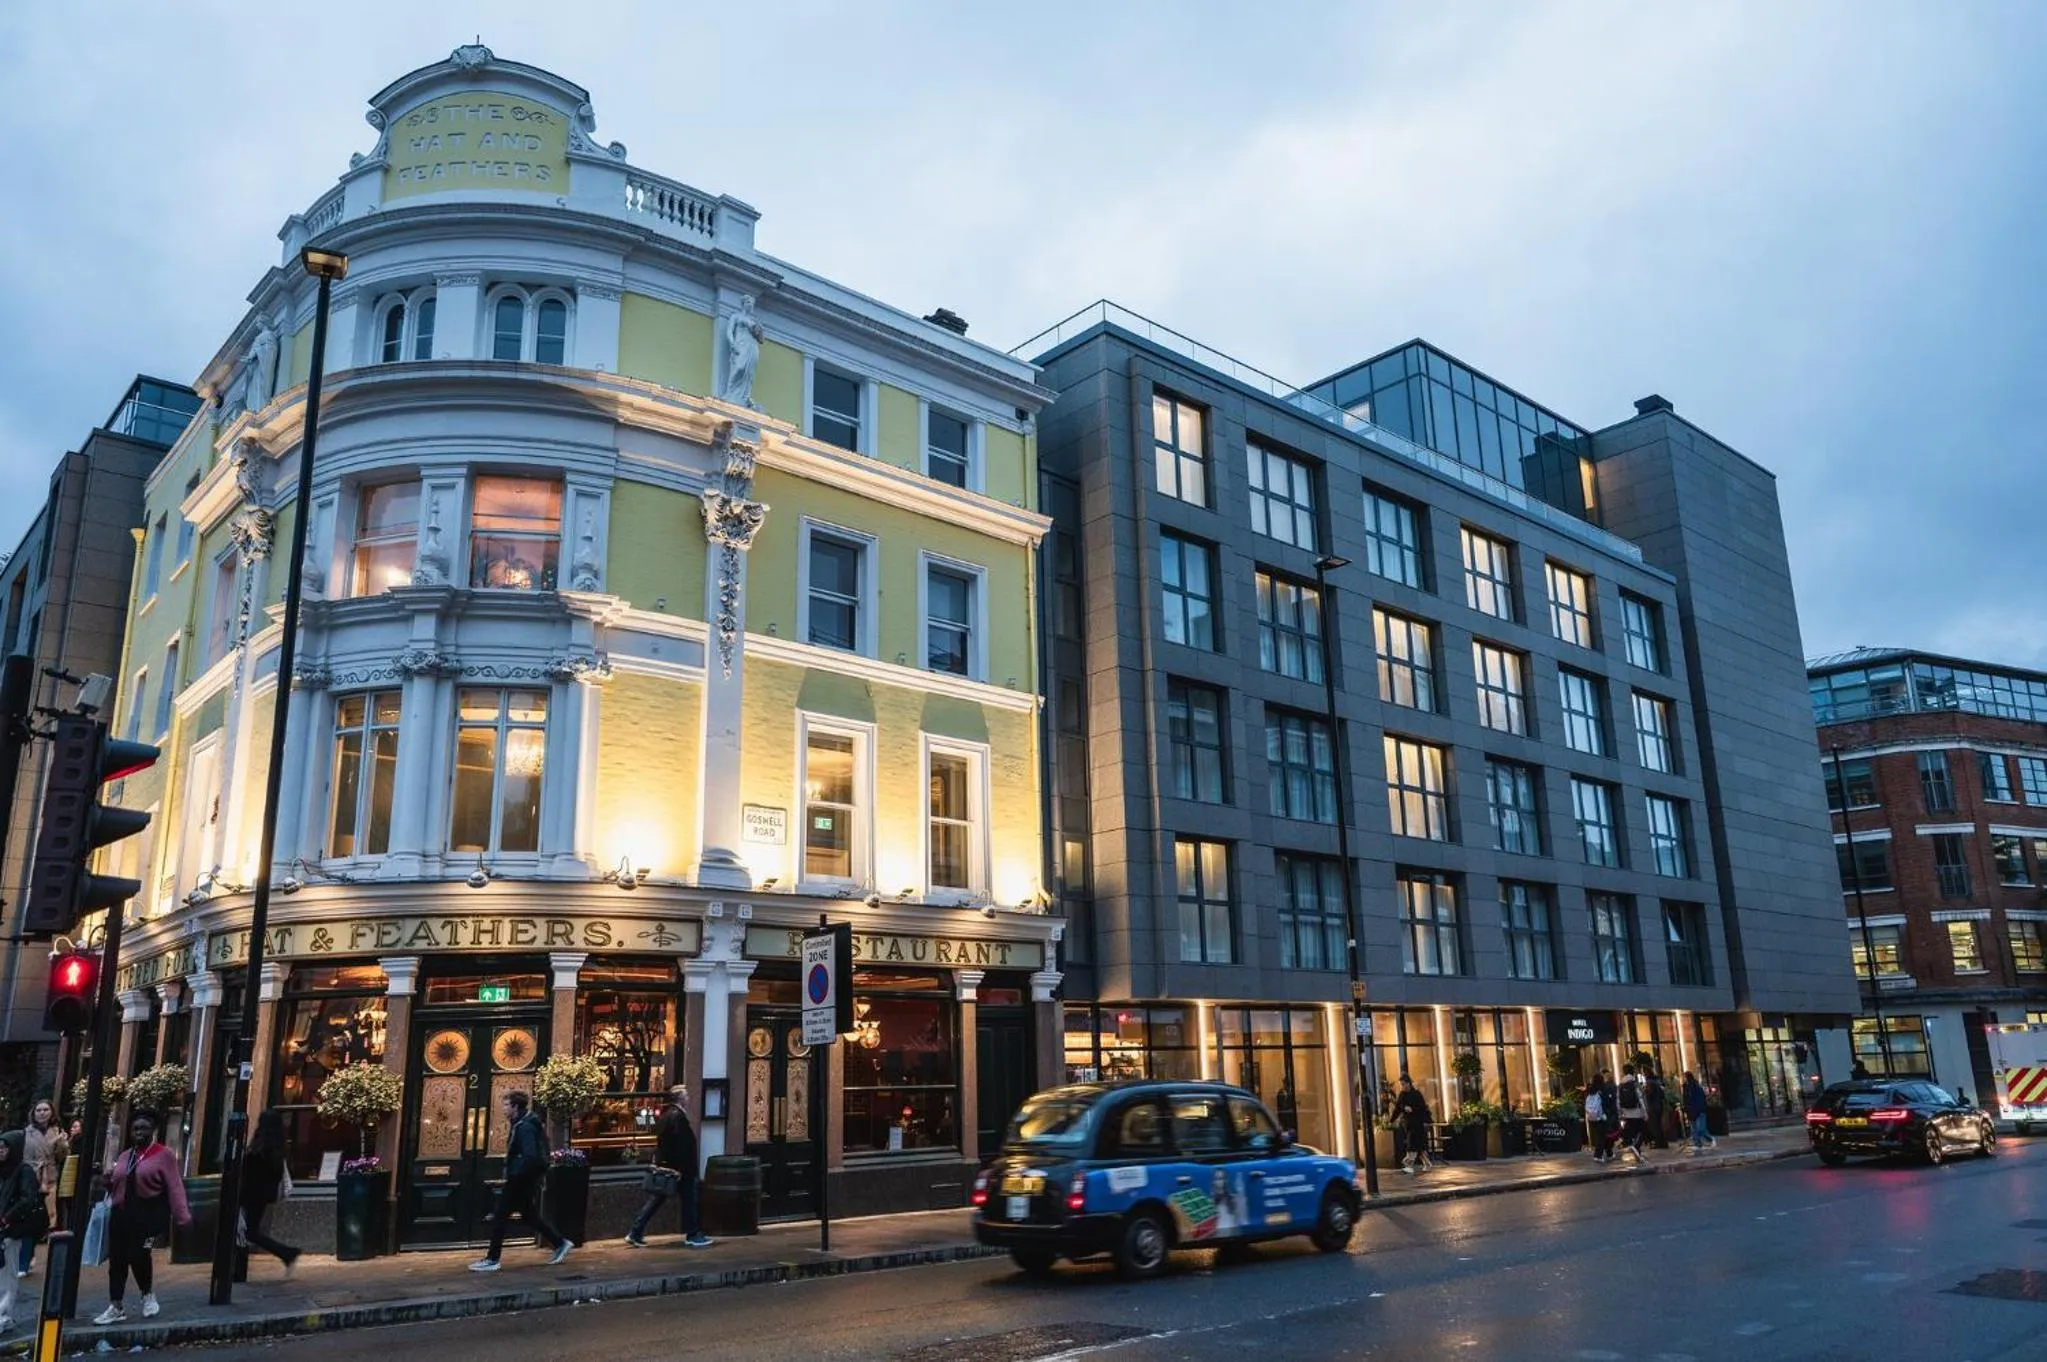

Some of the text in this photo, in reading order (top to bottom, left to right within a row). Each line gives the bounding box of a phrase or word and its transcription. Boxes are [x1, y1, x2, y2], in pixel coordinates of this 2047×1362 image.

[443, 103, 505, 123] THE
[409, 130, 543, 153] HAT AND
[397, 161, 553, 185] FEATHERS
[746, 813, 783, 828] GOSWELL
[752, 826, 776, 837] ROAD
[309, 927, 334, 952] &
[787, 931, 1013, 965] RSTAURANT
[809, 949, 828, 962] ZONE
[1567, 1028, 1594, 1040] INDIGO
[469, 1073, 479, 1089] 2
